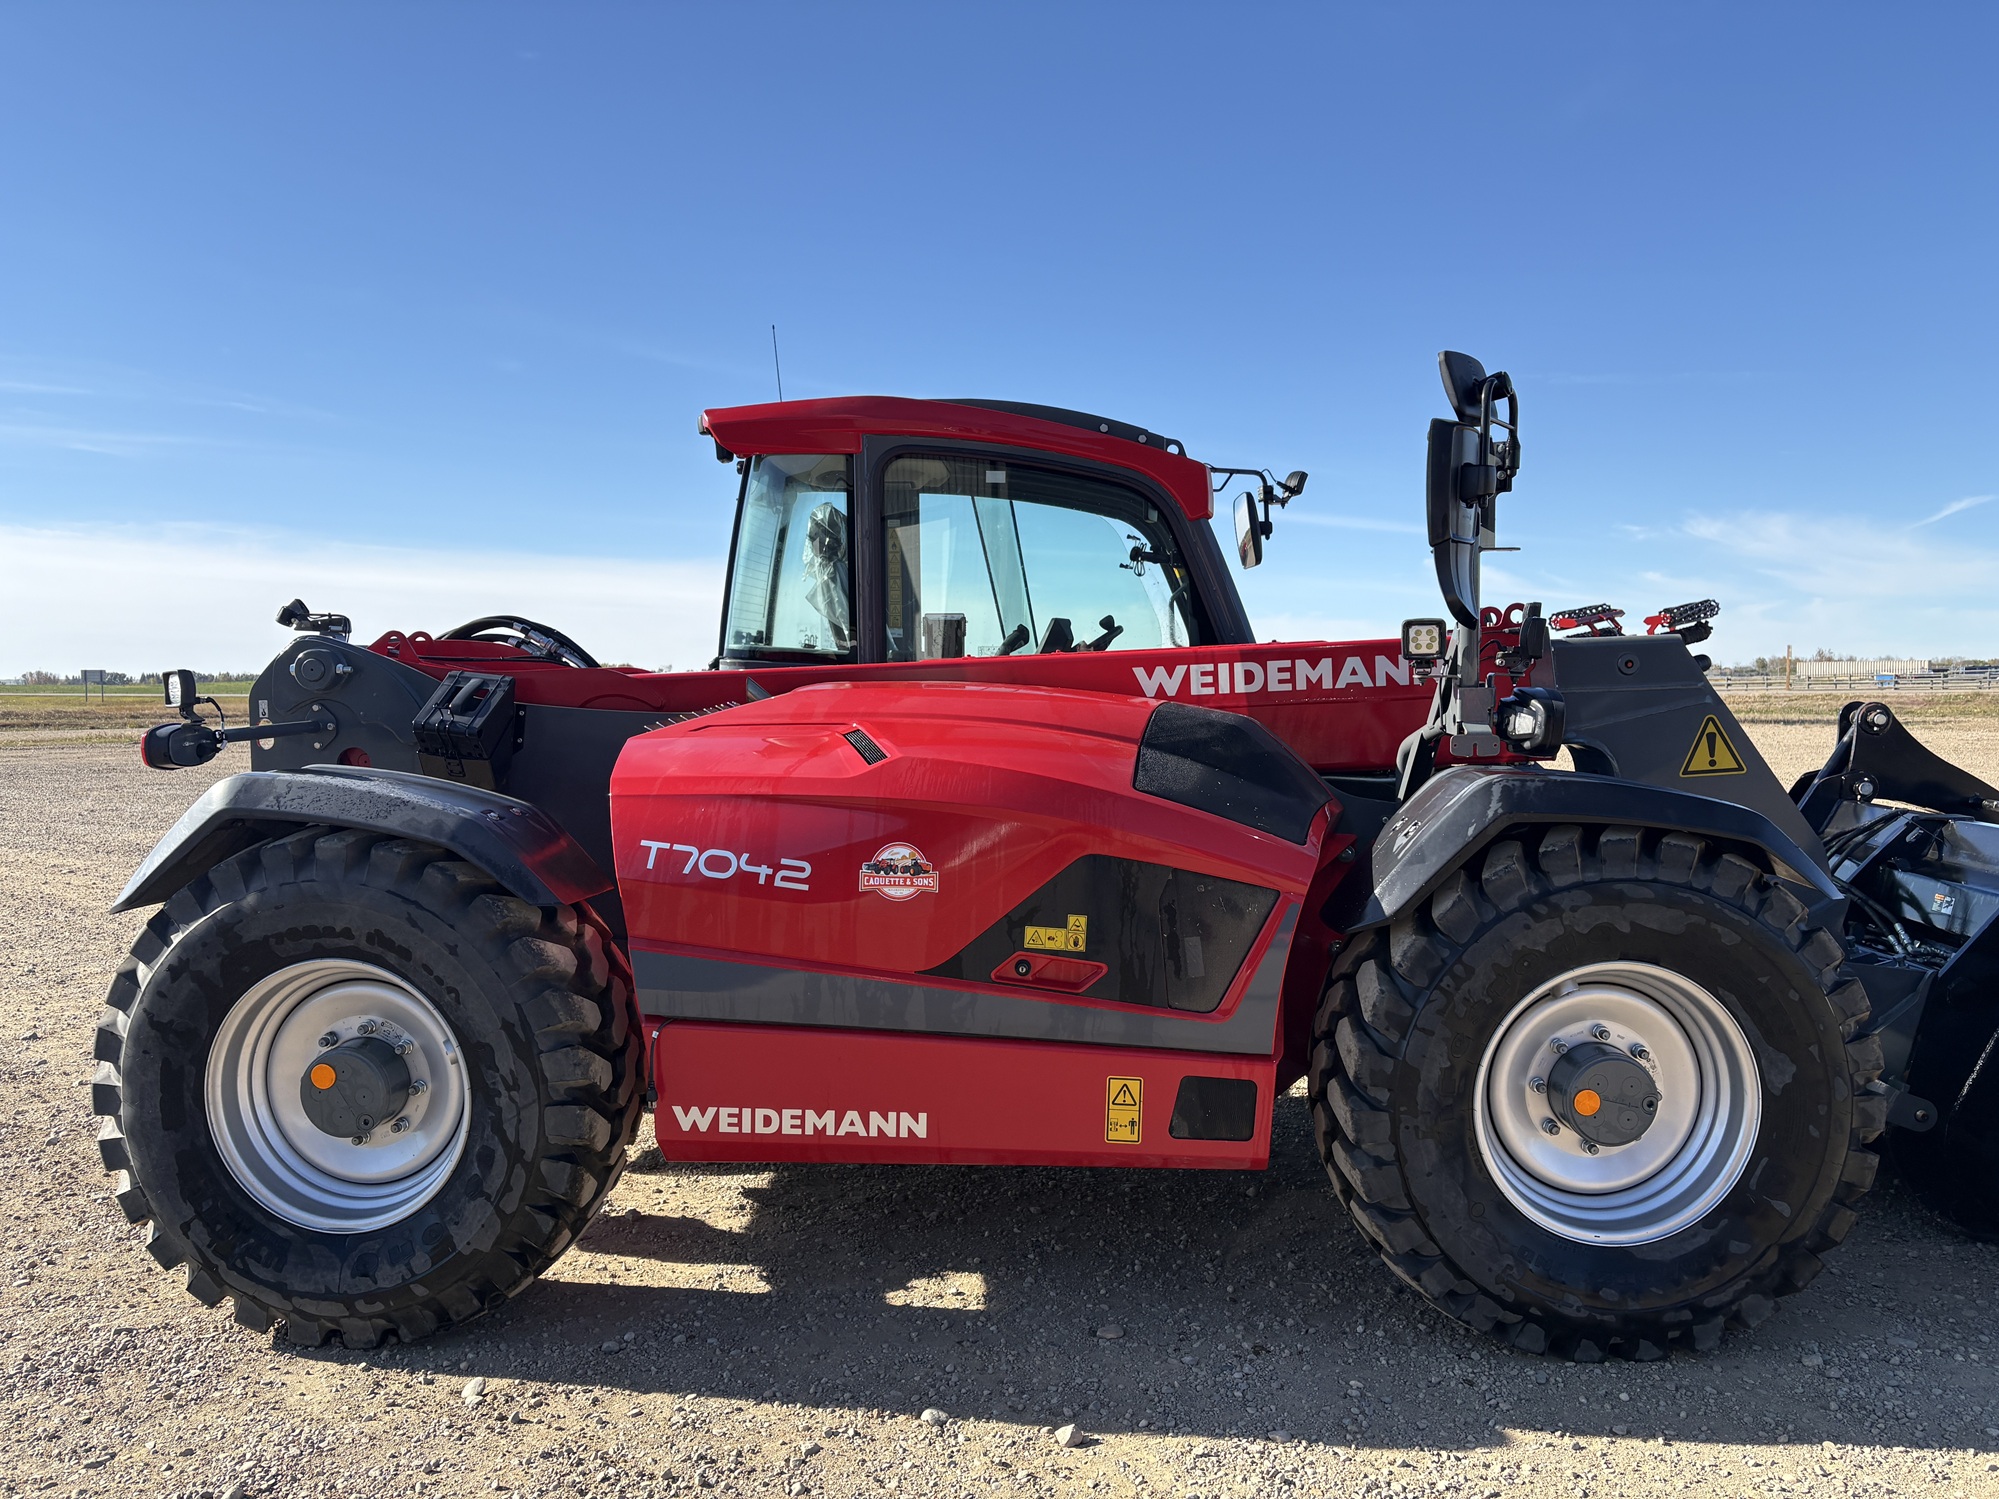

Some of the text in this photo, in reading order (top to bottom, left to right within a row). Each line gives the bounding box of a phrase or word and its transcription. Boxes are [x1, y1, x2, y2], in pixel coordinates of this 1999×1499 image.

[640, 839, 812, 891] T7042
[906, 878, 911, 886] &
[913, 878, 934, 887] SONS
[671, 1105, 928, 1139] WEIDEMANN
